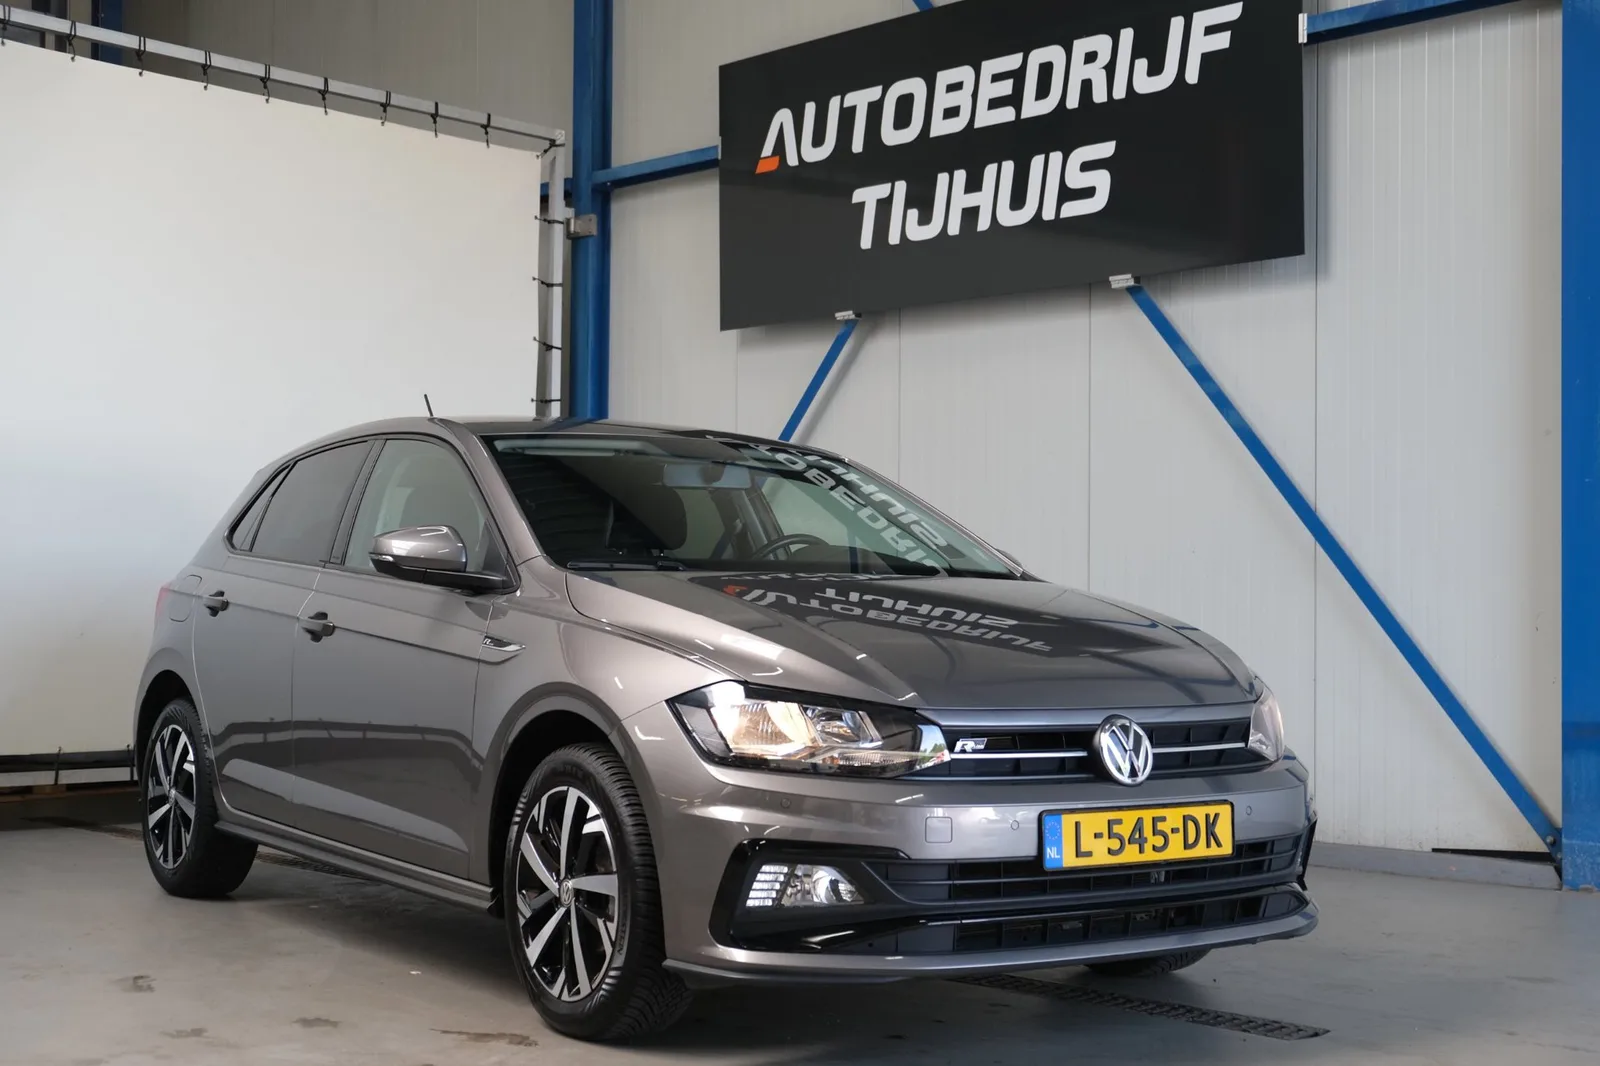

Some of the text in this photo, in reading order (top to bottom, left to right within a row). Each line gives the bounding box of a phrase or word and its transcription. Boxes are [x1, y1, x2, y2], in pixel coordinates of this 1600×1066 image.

[755, 2, 1243, 173] AUTOBEDRIJF
[852, 141, 1116, 250] TIJHUIS
[1047, 847, 1061, 859] NL
[1075, 813, 1223, 858] L-545-DK
